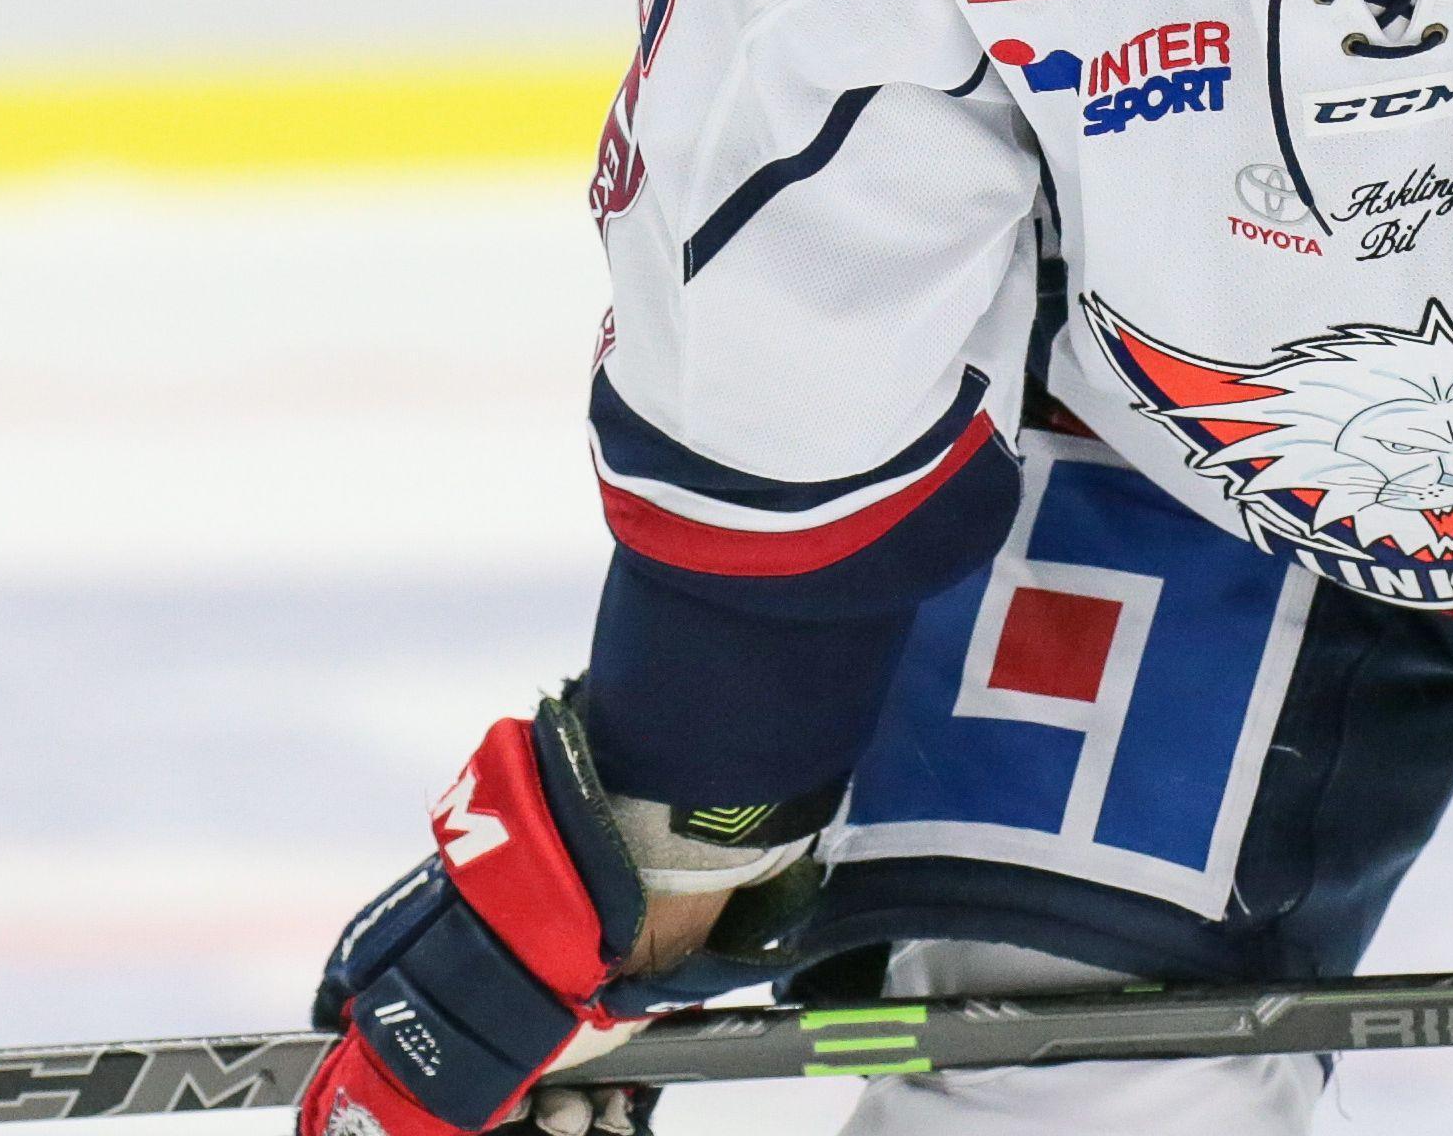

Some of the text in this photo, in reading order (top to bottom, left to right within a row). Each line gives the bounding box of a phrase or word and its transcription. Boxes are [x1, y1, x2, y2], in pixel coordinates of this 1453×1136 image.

[1087, 20, 1231, 98] INTER
[1082, 66, 1233, 138] SPORT
[1227, 215, 1323, 257] TOYOTA
[1355, 208, 1432, 262] Bil
